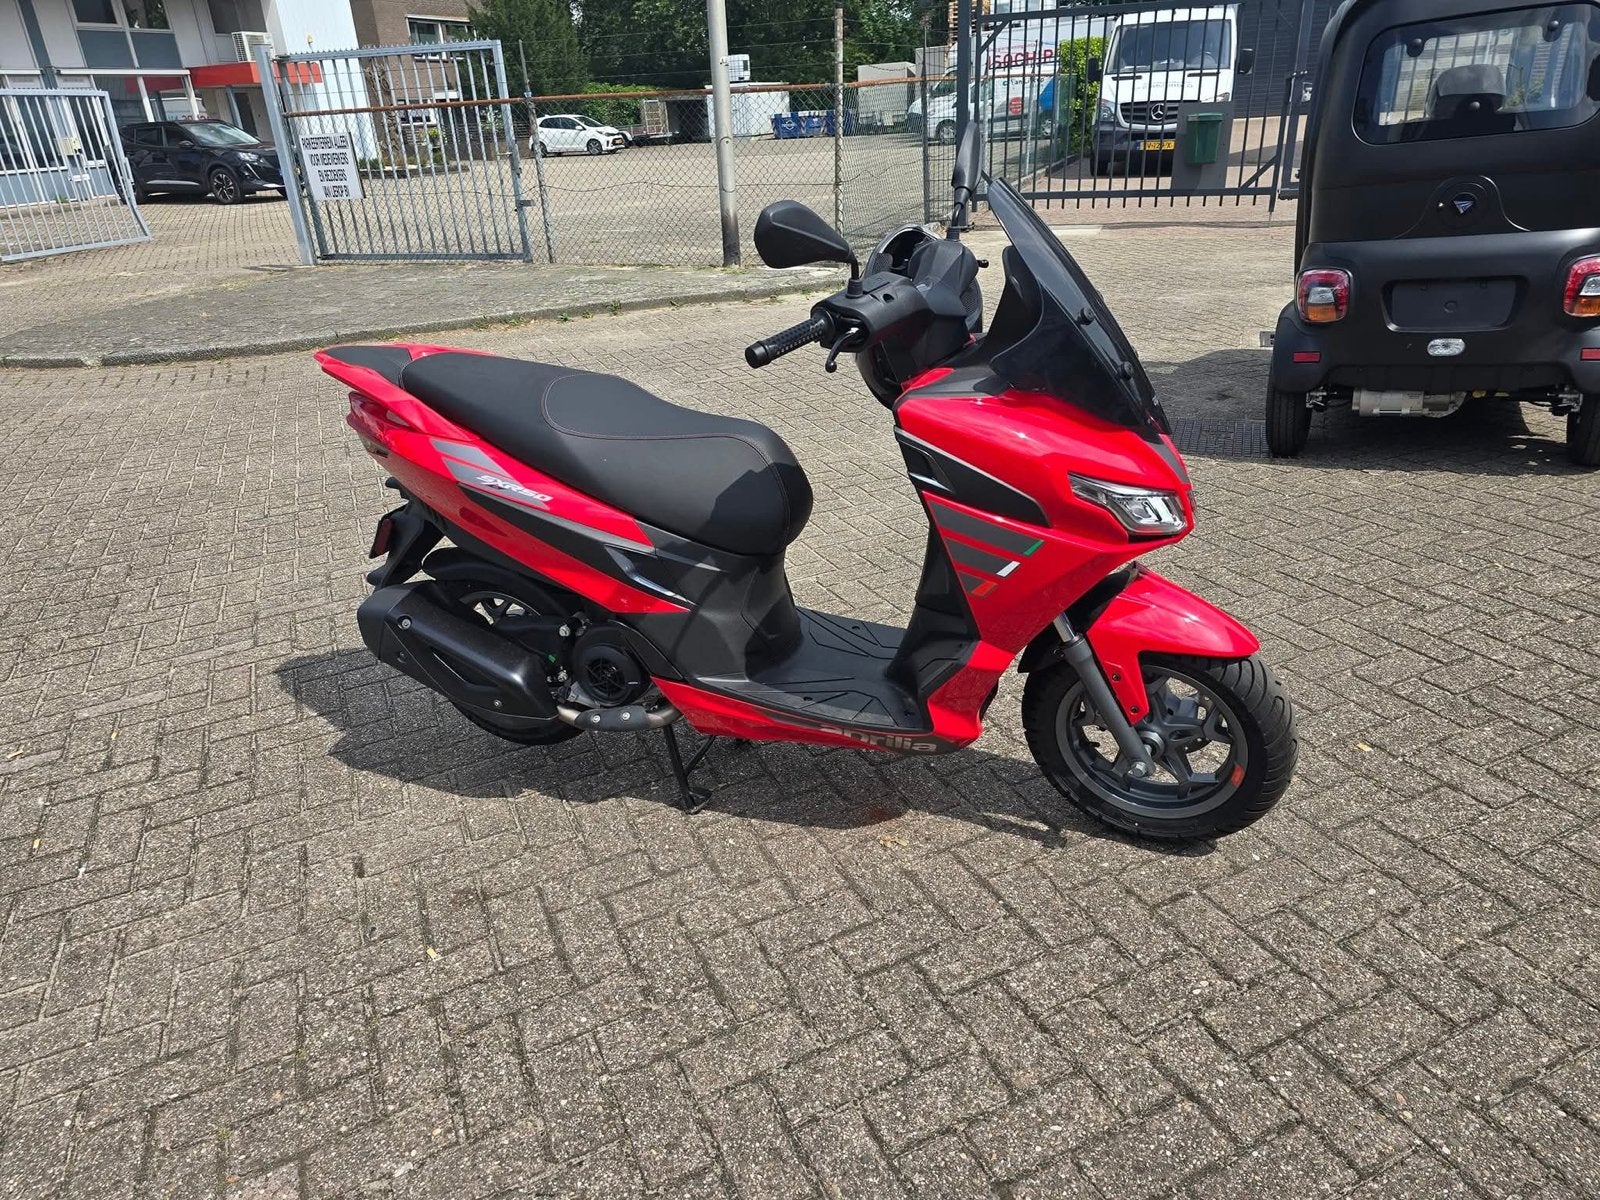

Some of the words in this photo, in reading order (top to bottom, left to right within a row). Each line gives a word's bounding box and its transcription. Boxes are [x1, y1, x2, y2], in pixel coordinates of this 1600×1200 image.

[333, 135, 349, 149] ALLEEN
[309, 153, 321, 166] VOOR
[320, 152, 349, 165] MEDEWERKERS
[324, 169, 347, 182] BEZOEKERS
[322, 185, 331, 198] VAN
[476, 475, 554, 502] SXR50
